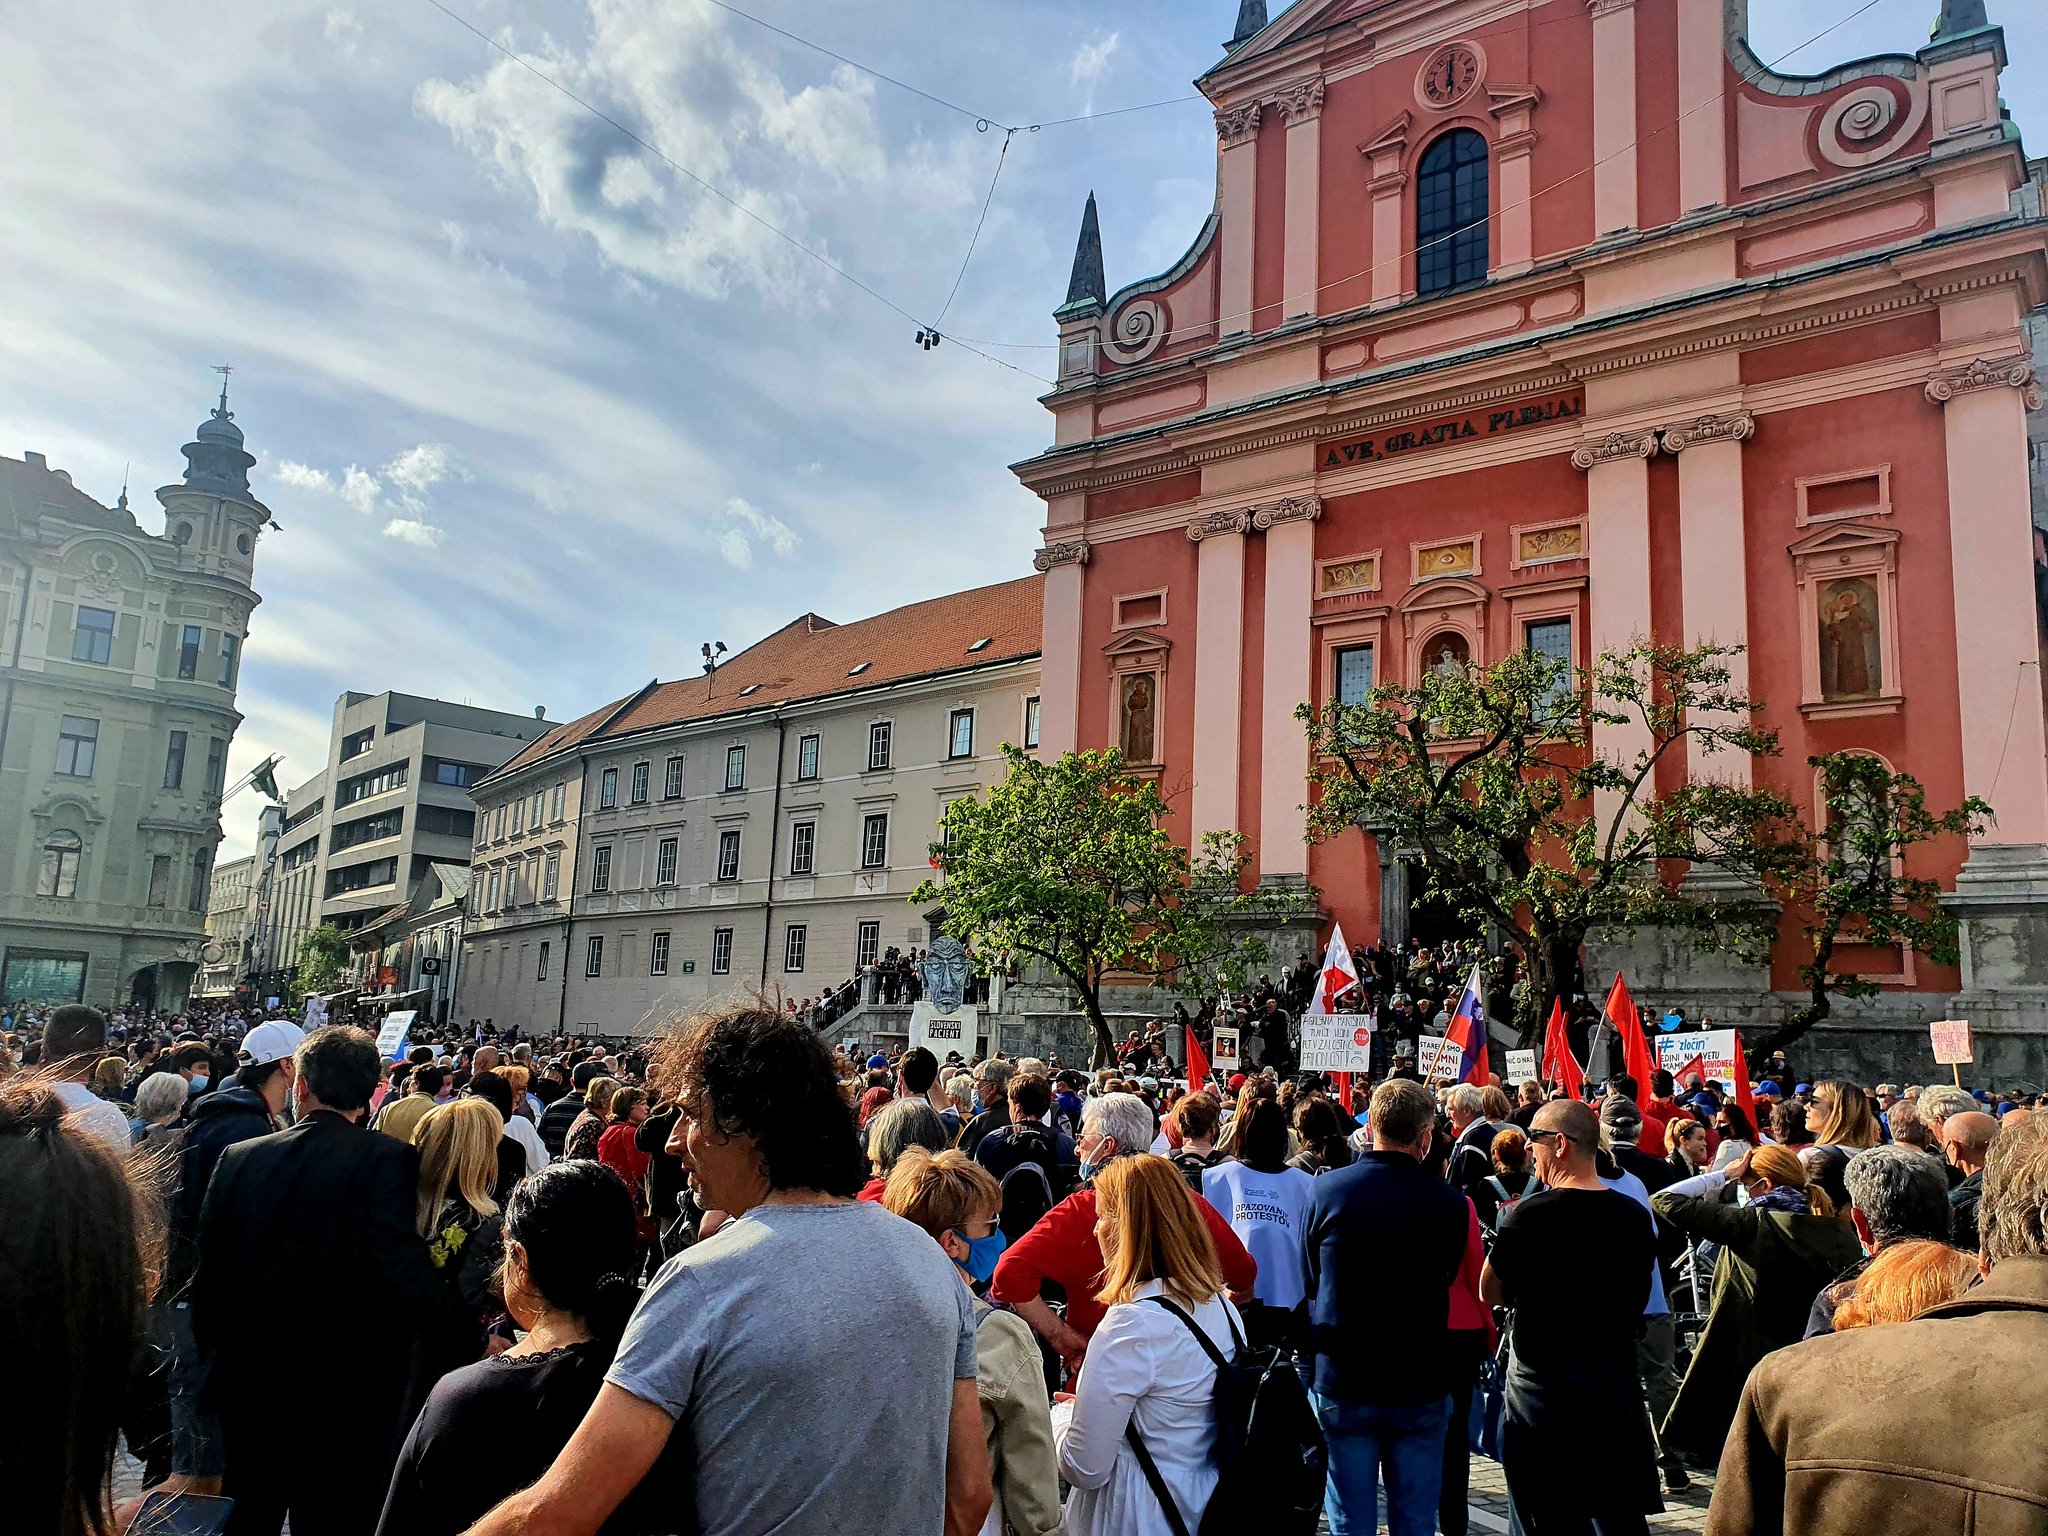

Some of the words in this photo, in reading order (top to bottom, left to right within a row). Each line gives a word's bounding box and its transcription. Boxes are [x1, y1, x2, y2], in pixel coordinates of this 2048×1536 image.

[1385, 420, 1478, 453] GRATIA
[1488, 396, 1580, 433] PLENA!
[930, 1020, 961, 1029] SLOVENSKI
[929, 1029, 959, 1038] PACIENT
[1236, 1211, 1290, 1228] PROTESTOV
